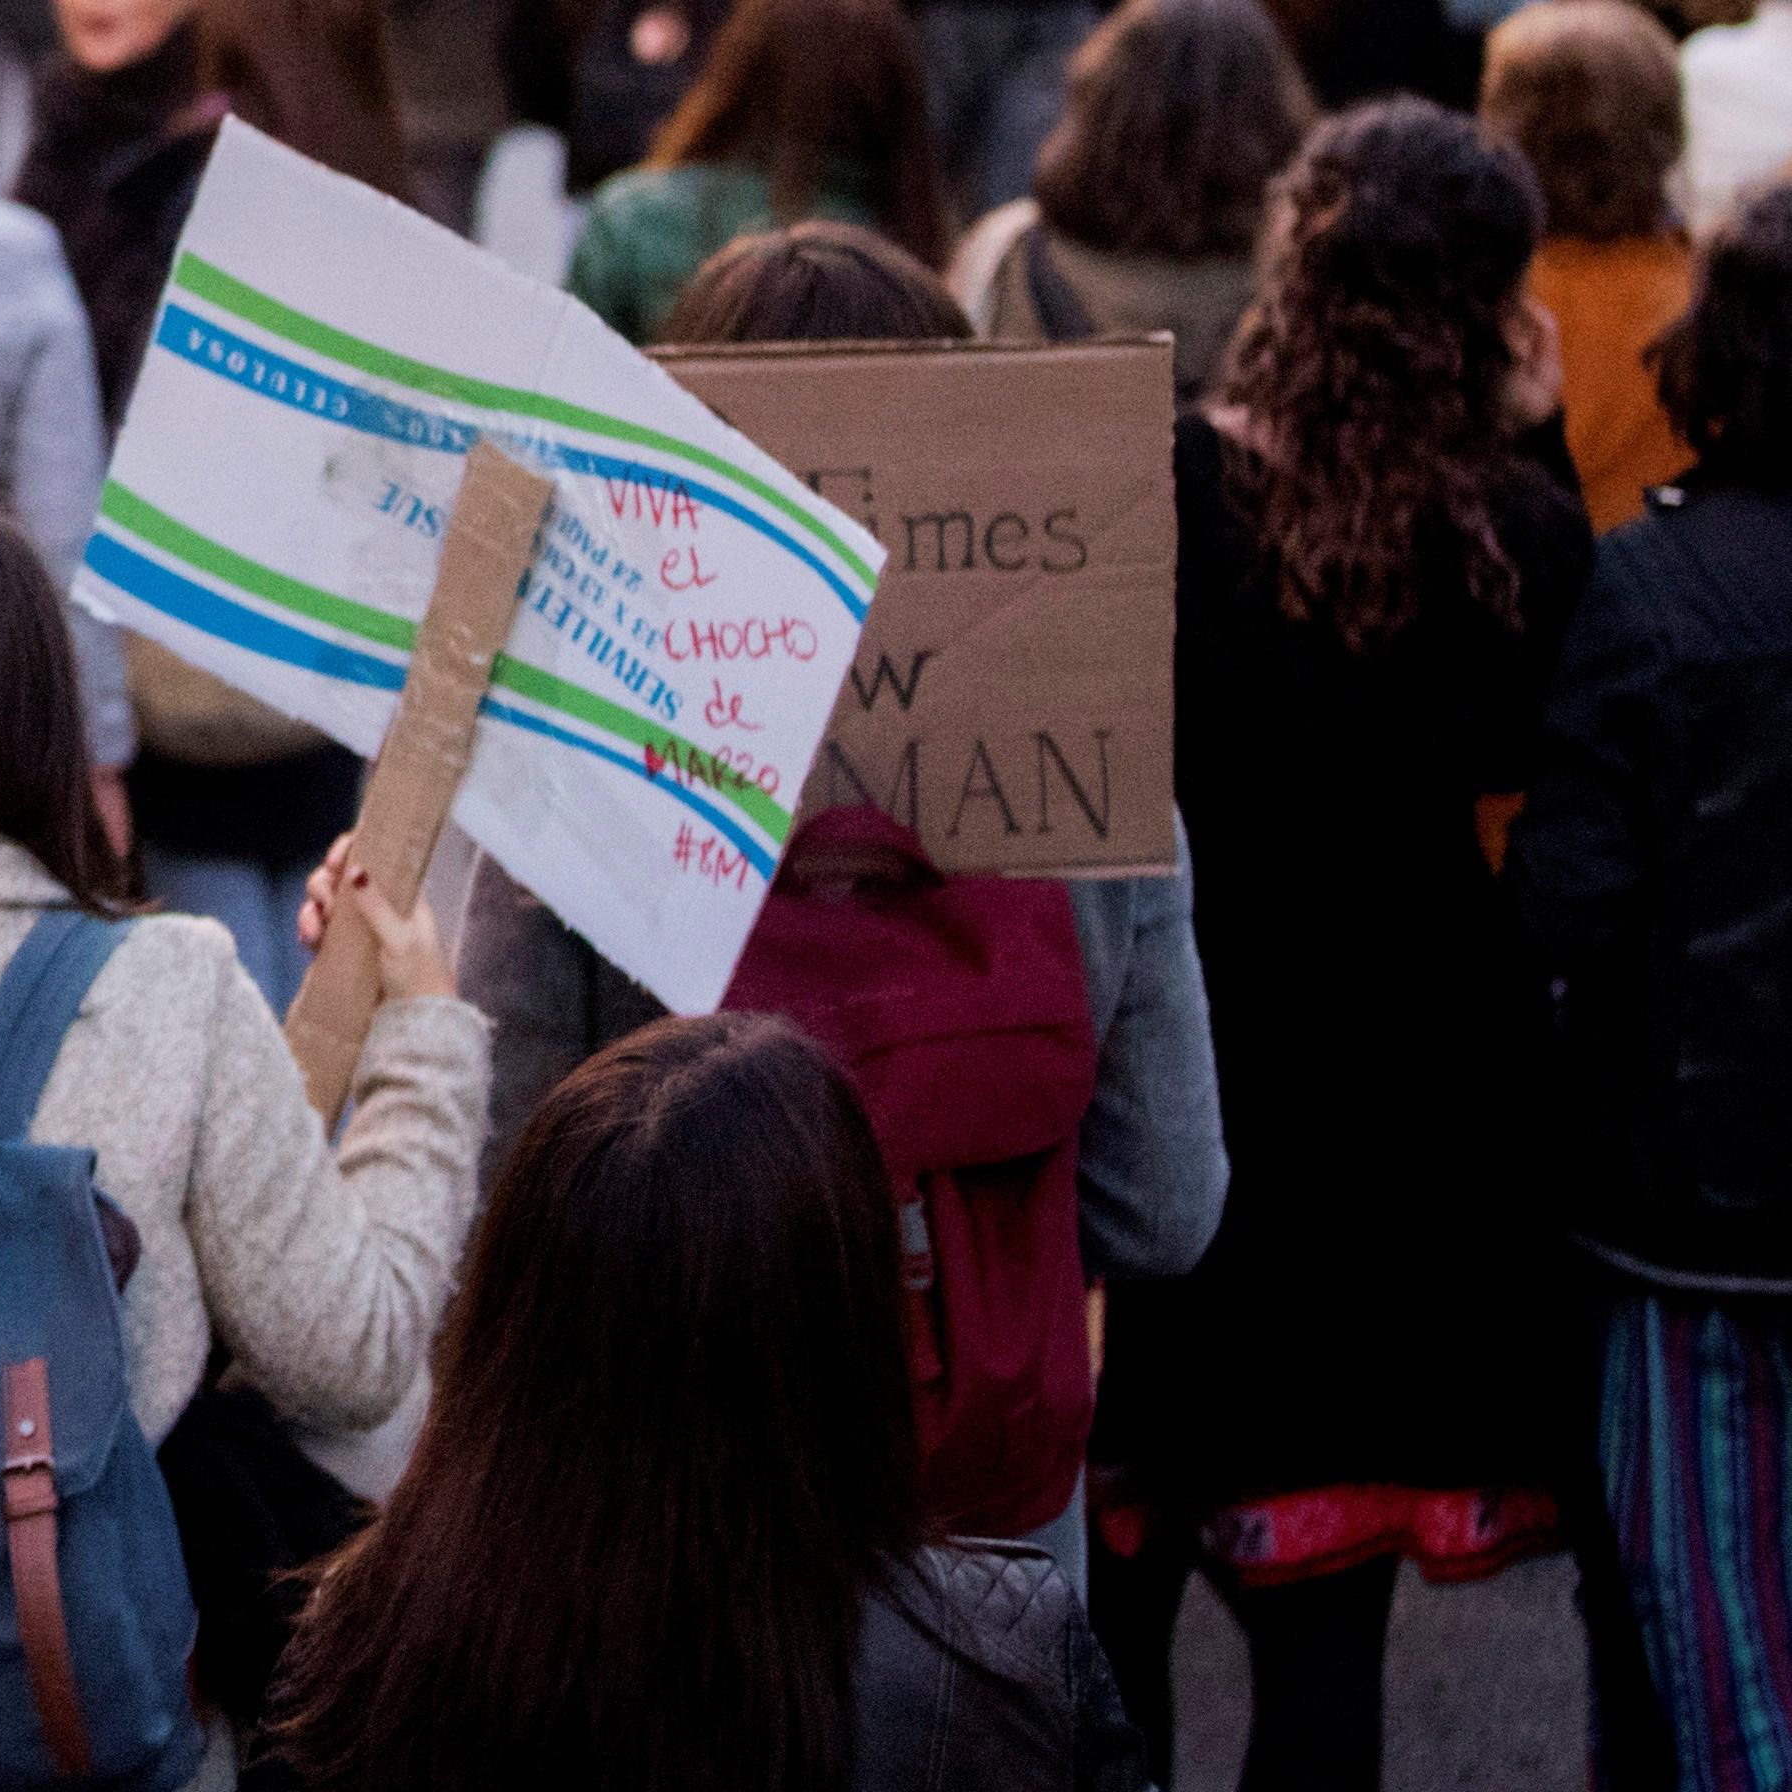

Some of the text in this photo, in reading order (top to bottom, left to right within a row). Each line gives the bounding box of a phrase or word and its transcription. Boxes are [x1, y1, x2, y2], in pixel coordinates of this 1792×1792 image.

[186, 325, 350, 419] CELULOSA
[372, 480, 450, 539] SUE
[605, 462, 701, 530] VIVA
[663, 616, 817, 662] CHOCHO
[703, 678, 763, 730] de
[815, 727, 1113, 841] MAN
